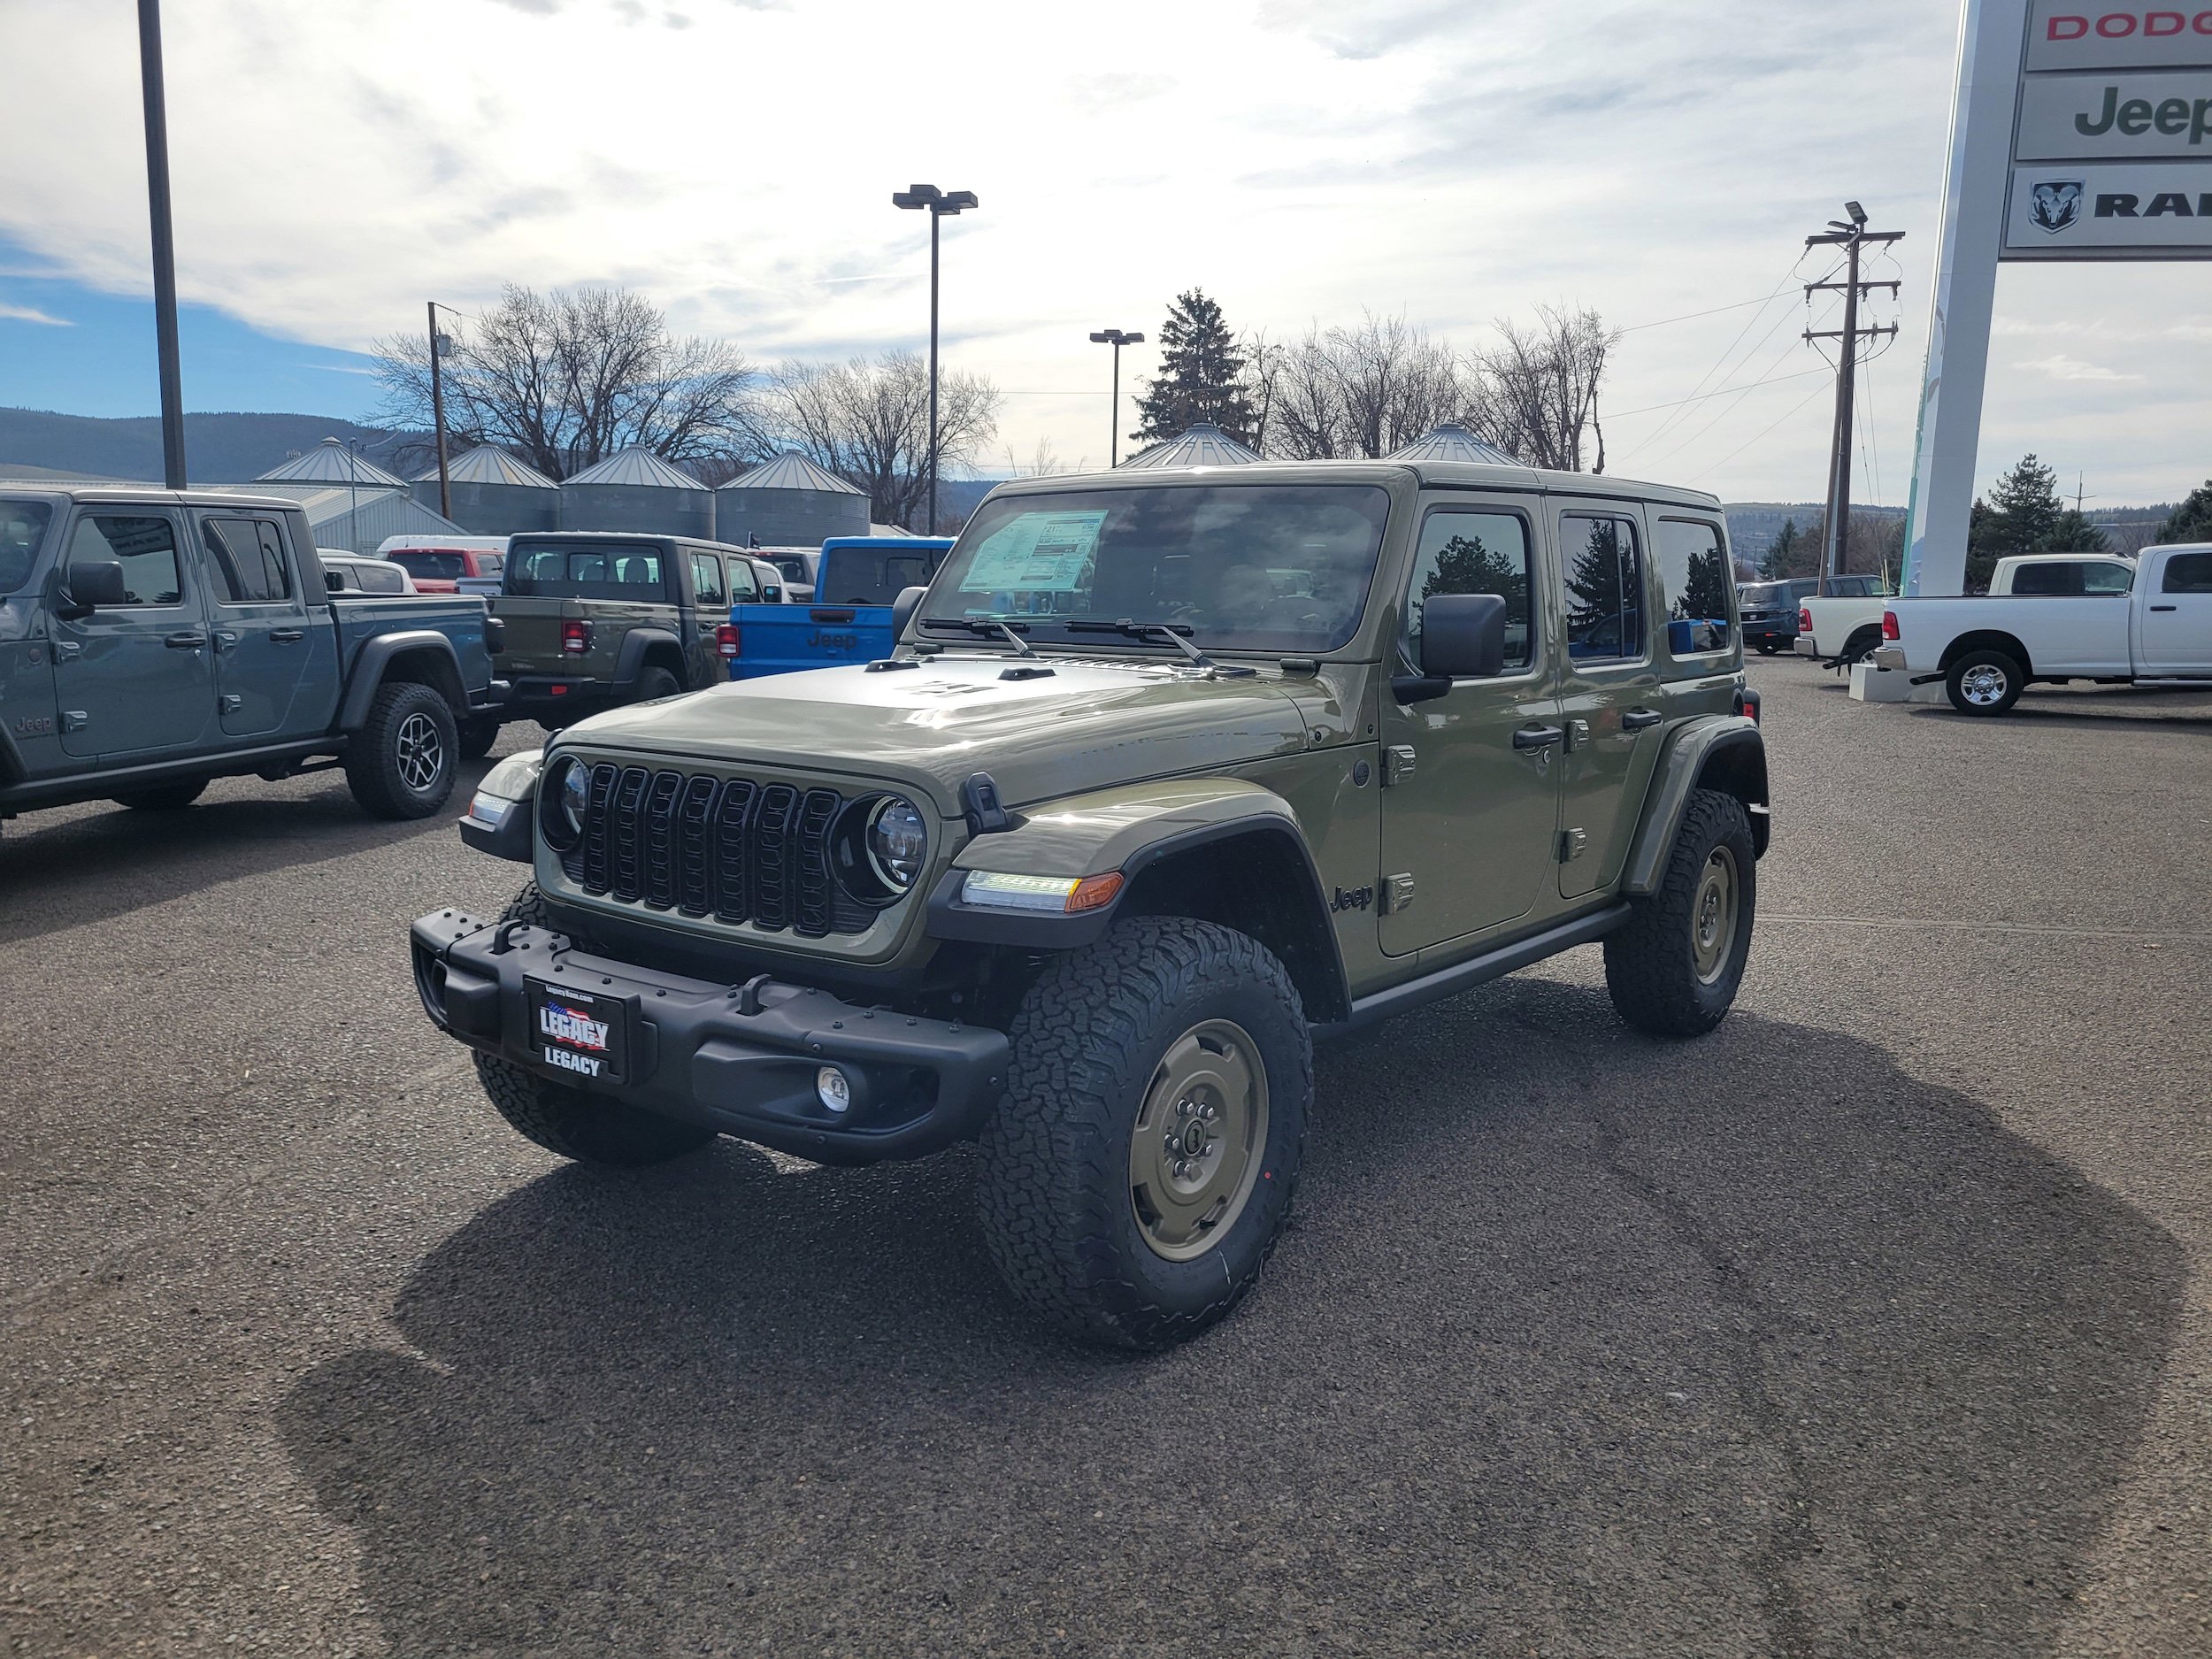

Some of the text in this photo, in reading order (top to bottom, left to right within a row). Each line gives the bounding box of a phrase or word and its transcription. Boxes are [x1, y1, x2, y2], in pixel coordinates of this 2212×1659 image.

[2075, 87, 2212, 144] Jeep
[2094, 193, 2212, 218] RA
[807, 630, 856, 651] Jeep
[14, 717, 51, 733] Jeep
[1329, 885, 1372, 913] Jeep
[540, 1008, 610, 1048] LEGACY
[544, 1047, 601, 1077] LEGACY
